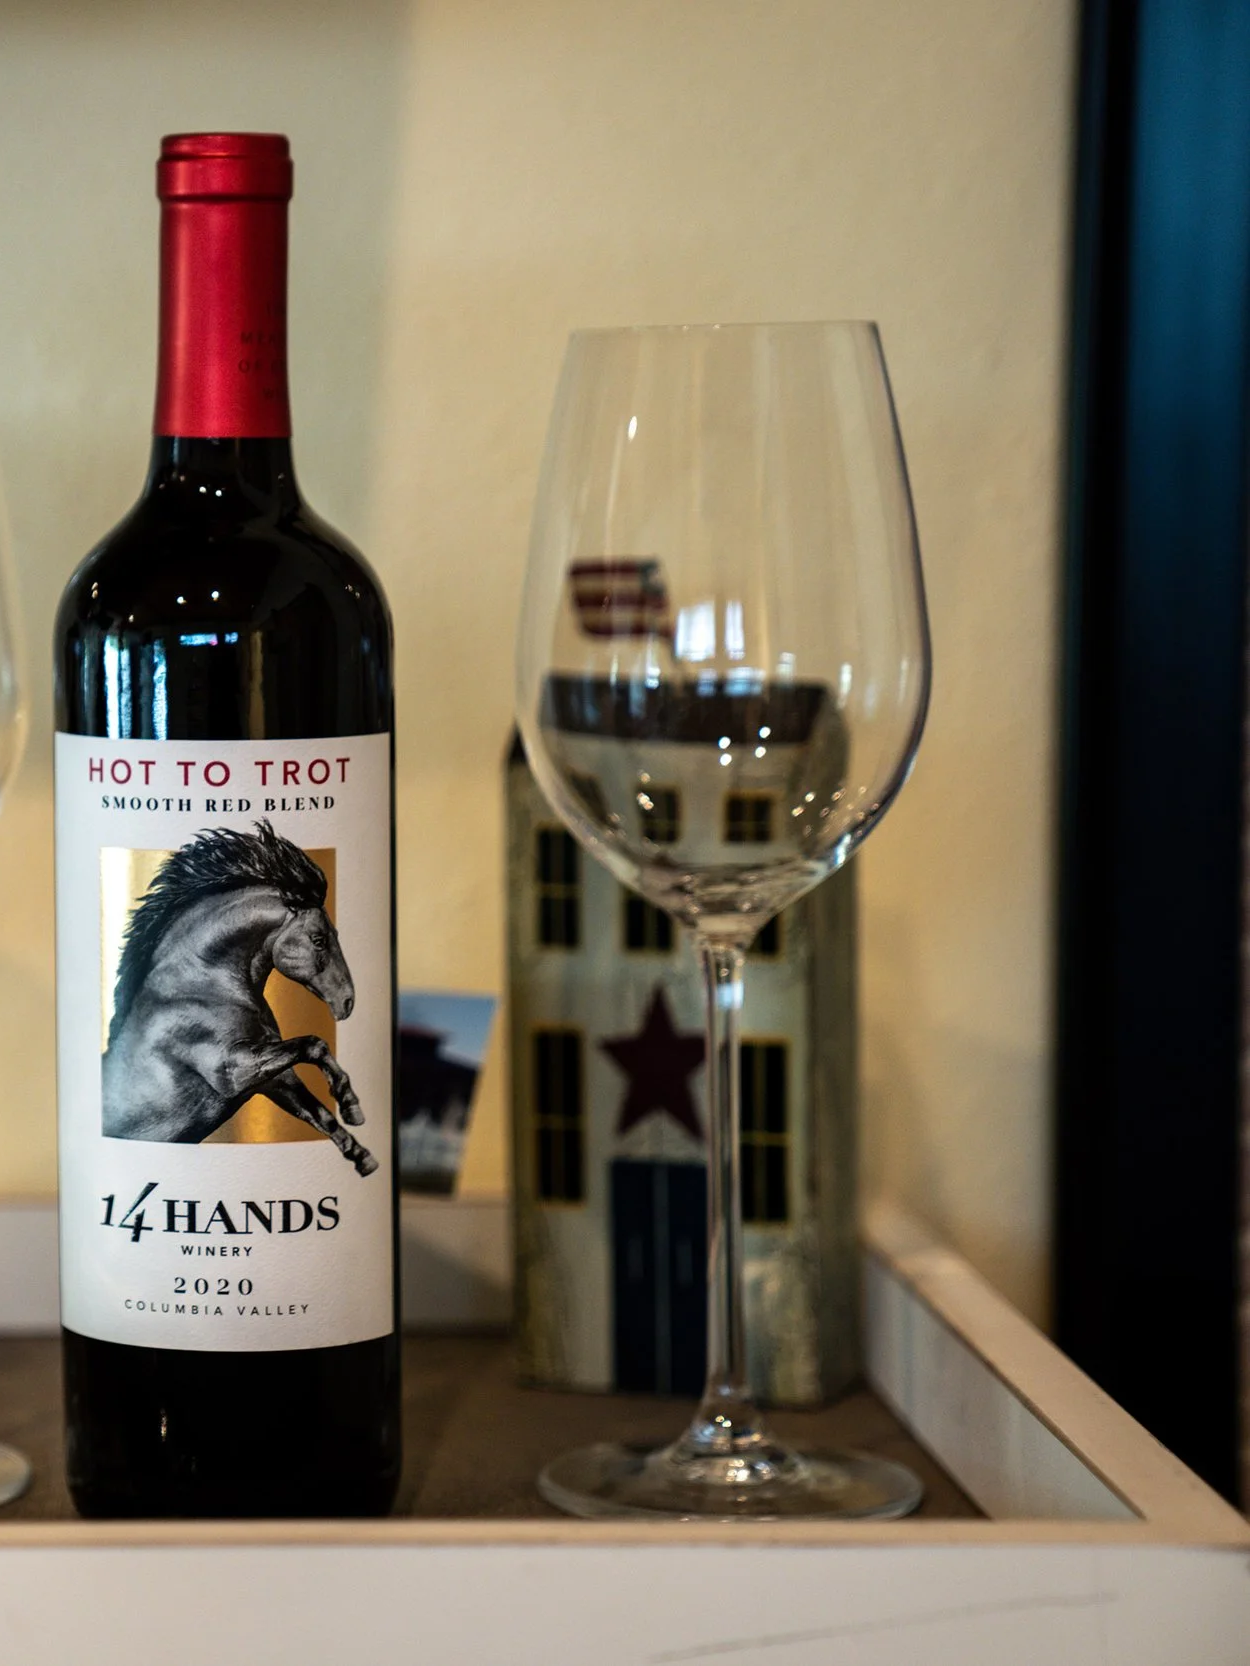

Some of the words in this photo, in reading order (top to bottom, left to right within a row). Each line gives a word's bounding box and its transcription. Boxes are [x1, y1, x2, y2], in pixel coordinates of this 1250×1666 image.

[88, 757, 157, 787] HOT
[176, 760, 232, 788] TO
[254, 756, 351, 787] TROT
[101, 795, 192, 812] SMOOTH
[205, 798, 252, 813] RED
[264, 795, 336, 812] BLEND
[99, 1181, 160, 1243] 14
[162, 1195, 341, 1235] HANDS
[180, 1245, 254, 1257] WINERY
[173, 1276, 254, 1296] 2020
[124, 1299, 224, 1316] COLUMBIA
[236, 1303, 310, 1316] VALLEY
